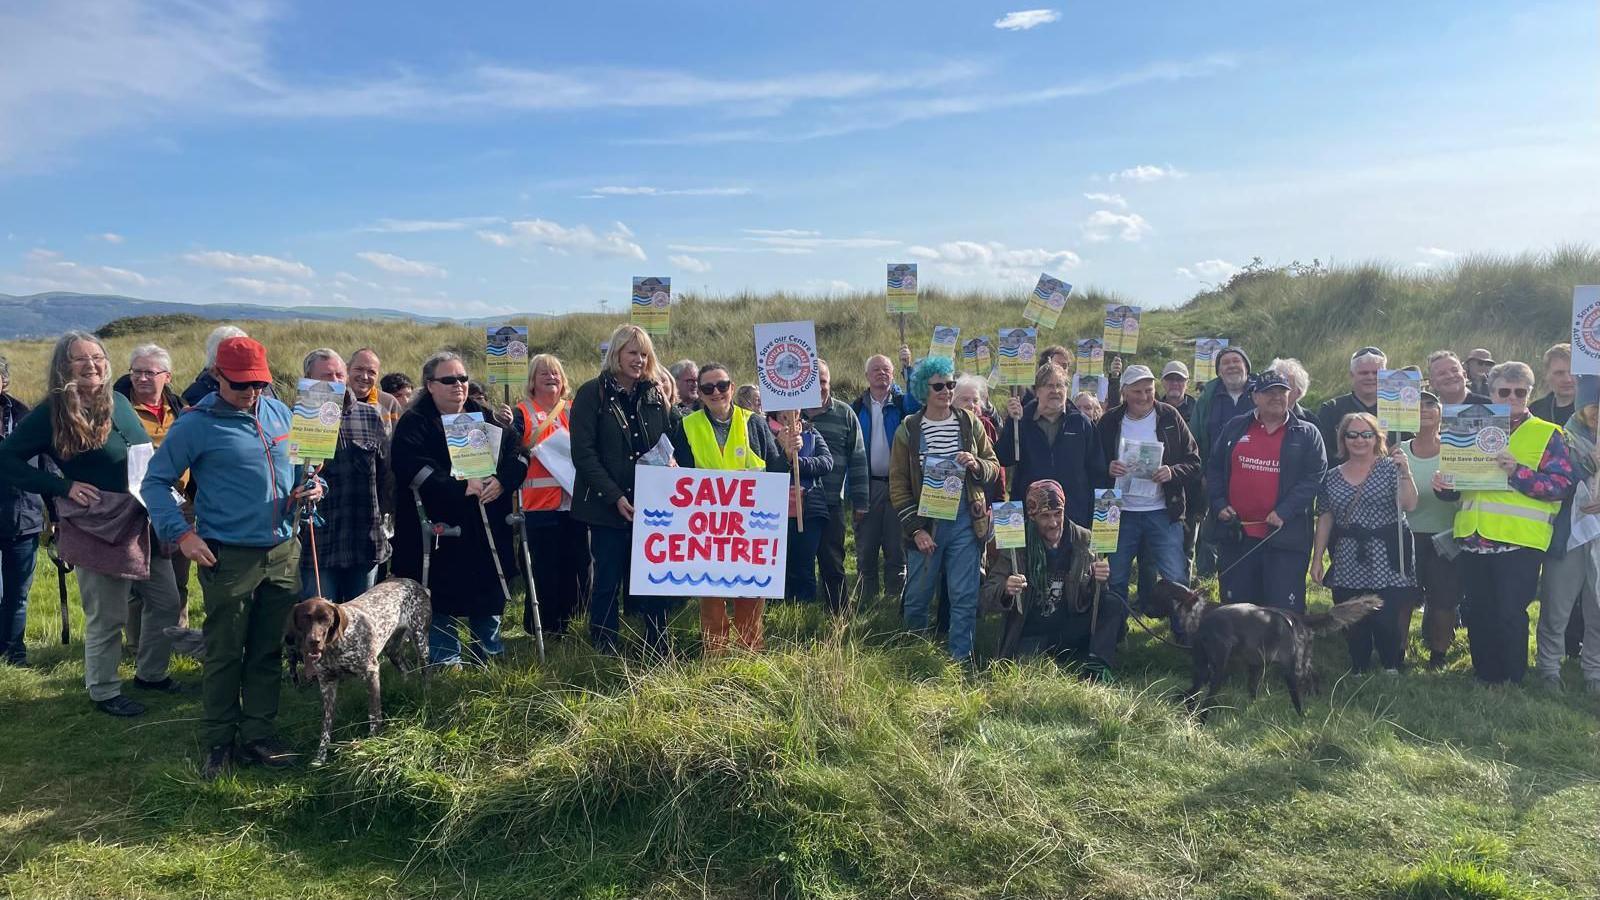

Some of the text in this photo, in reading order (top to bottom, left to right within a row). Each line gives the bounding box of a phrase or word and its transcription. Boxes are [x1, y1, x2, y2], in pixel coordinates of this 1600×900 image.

[760, 335, 812, 357] Save our Centre
[758, 366, 786, 397] Achubwch
[801, 359, 818, 393] Canolfan
[1239, 455, 1270, 466] Standard
[669, 477, 757, 508] SAVE
[688, 511, 746, 536] OUR
[644, 532, 779, 566] CENTRE!
